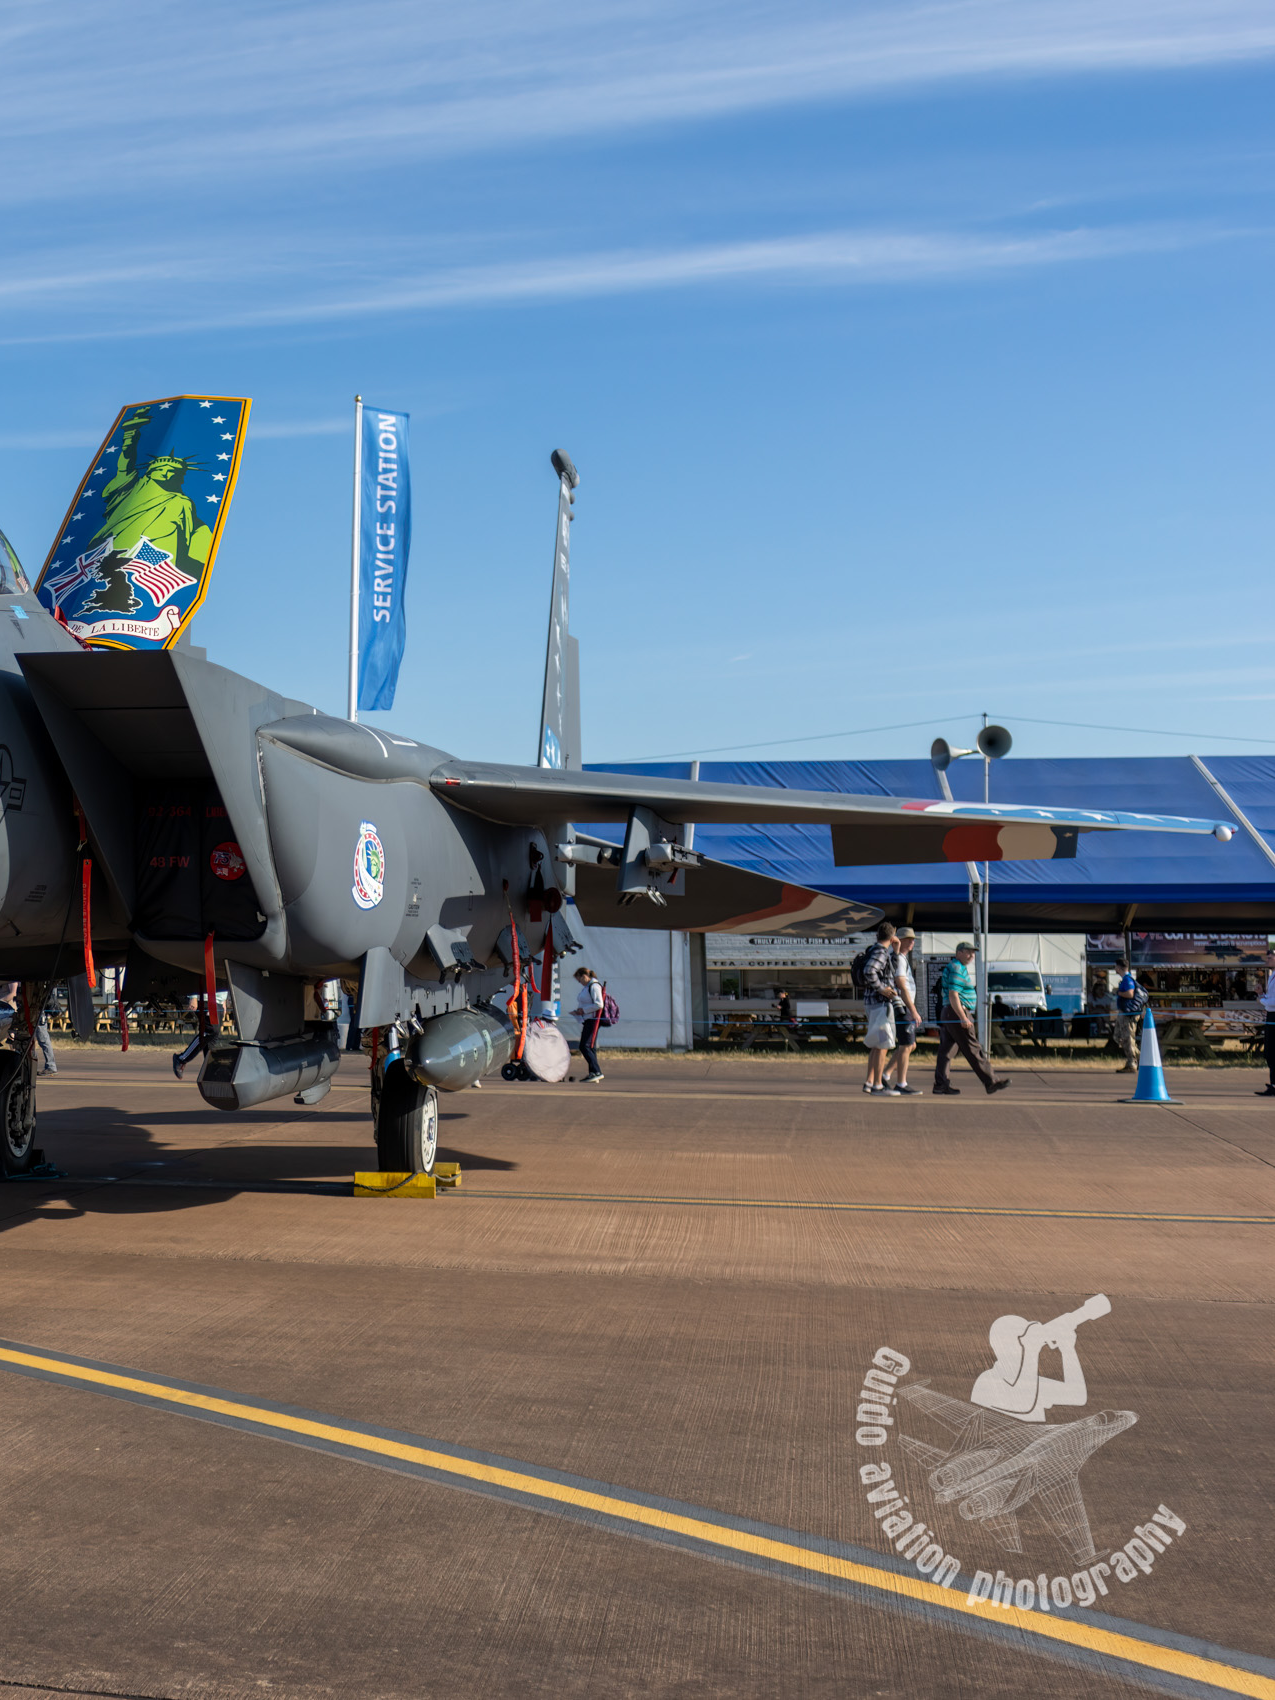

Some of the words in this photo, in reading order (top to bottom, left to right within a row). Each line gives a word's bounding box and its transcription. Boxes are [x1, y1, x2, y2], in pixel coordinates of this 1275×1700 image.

[377, 413, 398, 514] STATION
[373, 523, 395, 623] SERVICE
[71, 624, 85, 634] DE
[91, 624, 106, 634] LA
[112, 623, 160, 637] LIBERTE
[150, 856, 166, 868] 48
[170, 856, 190, 868] FW
[213, 850, 231, 864] 75
